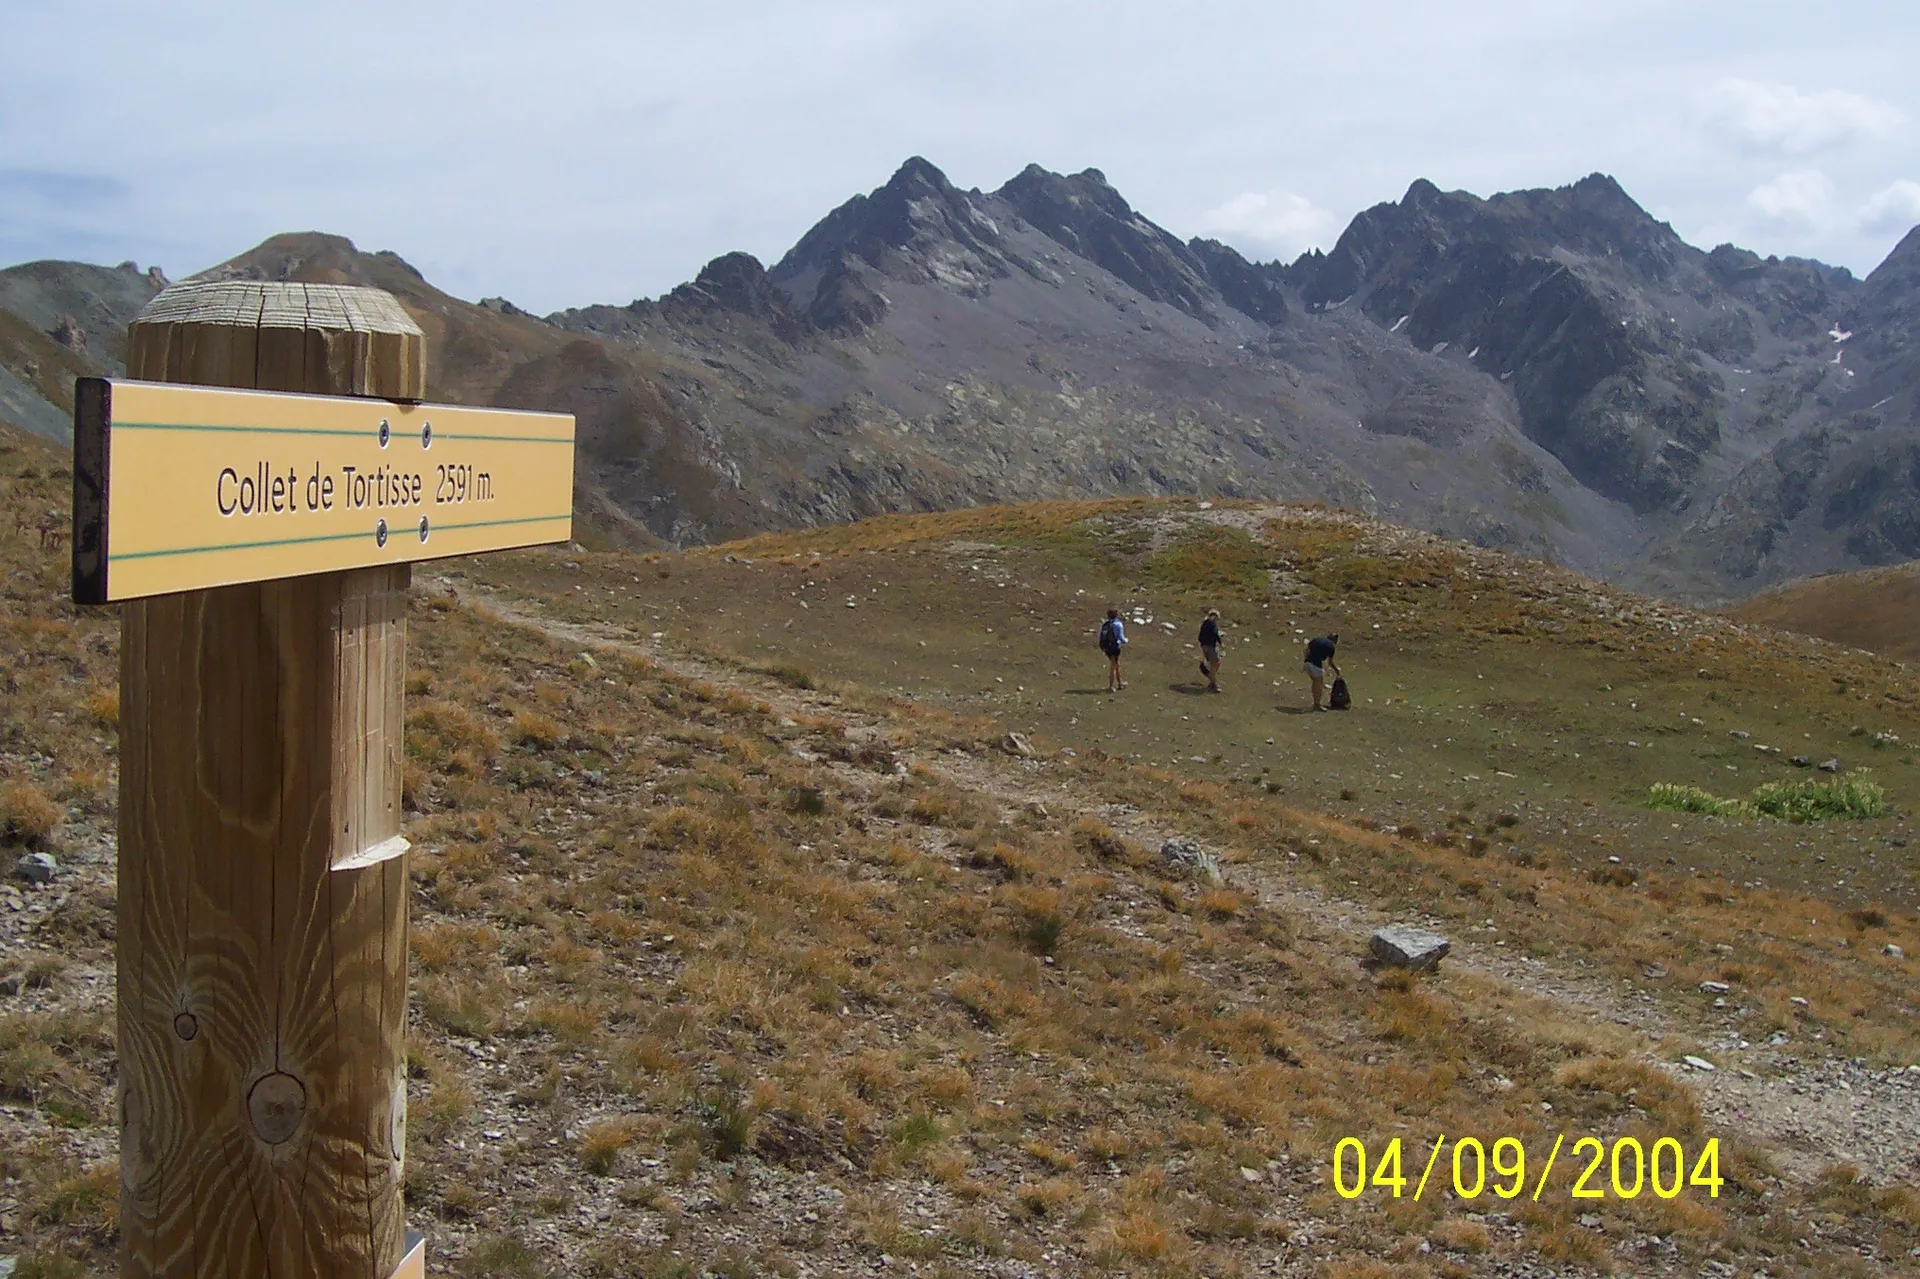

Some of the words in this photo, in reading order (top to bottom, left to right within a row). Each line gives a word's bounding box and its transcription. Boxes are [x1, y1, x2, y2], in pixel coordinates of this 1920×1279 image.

[217, 460, 298, 516] Collet
[306, 460, 335, 512] de
[342, 463, 422, 508] Tortisse
